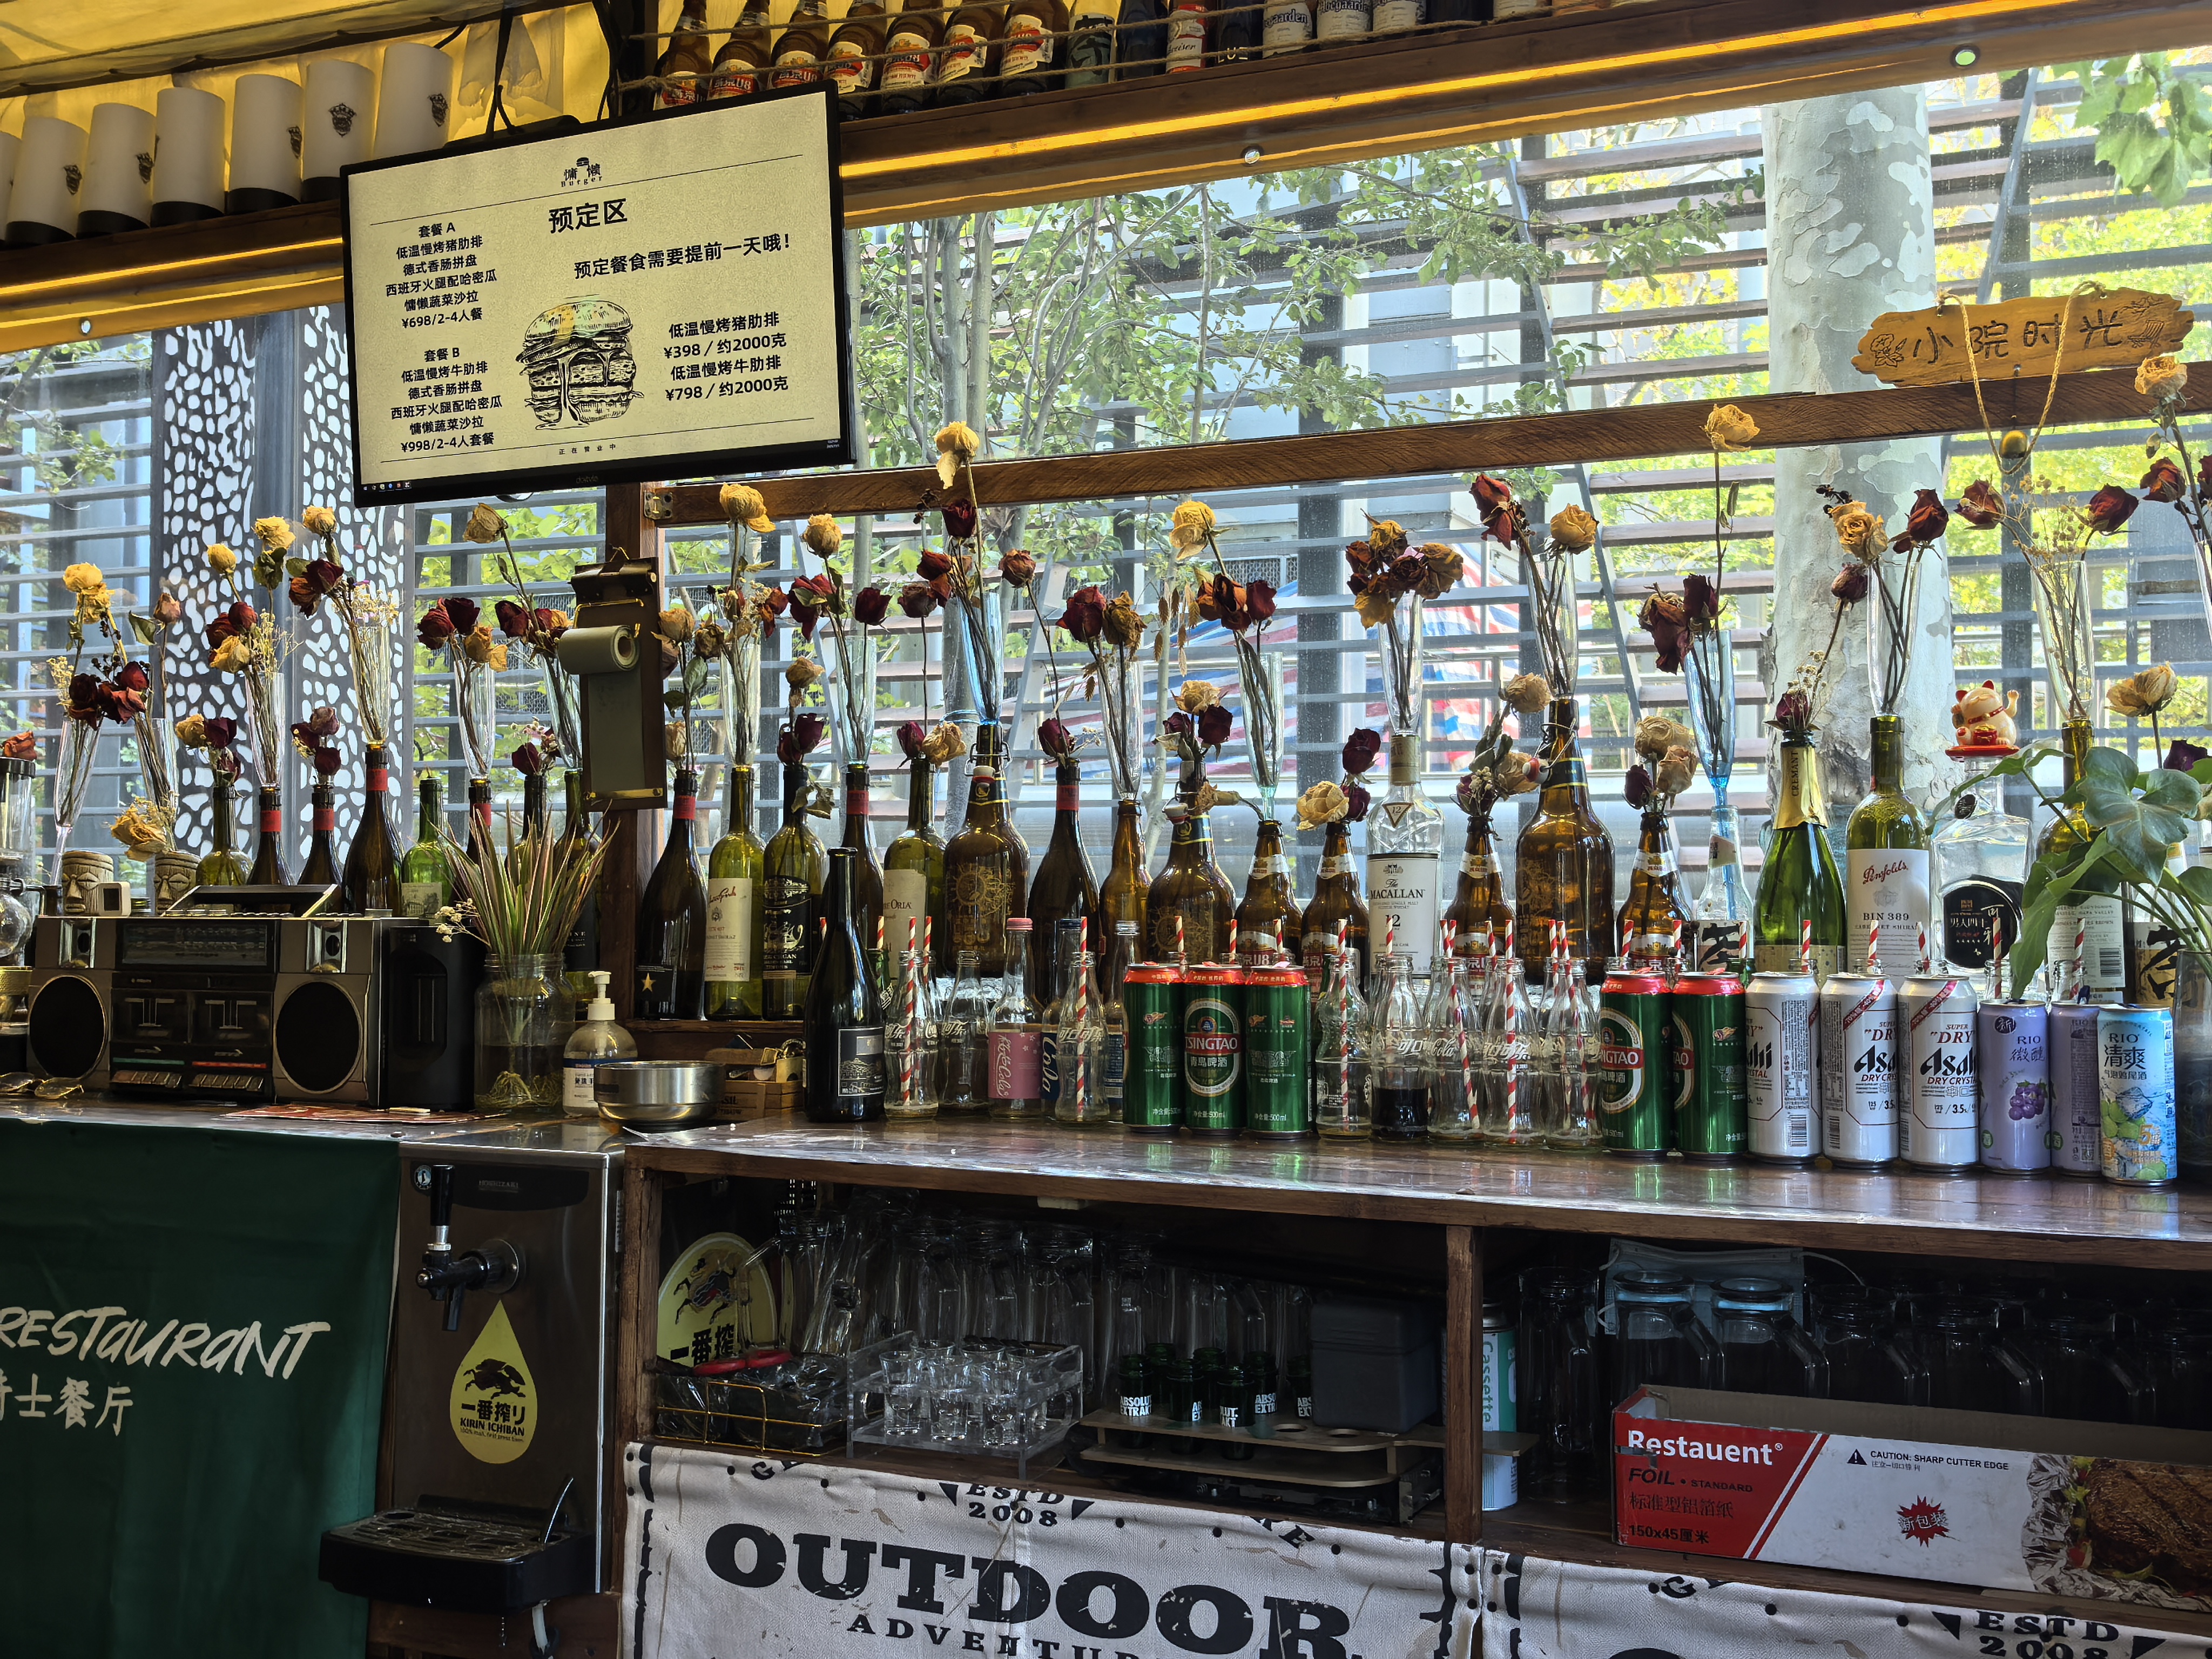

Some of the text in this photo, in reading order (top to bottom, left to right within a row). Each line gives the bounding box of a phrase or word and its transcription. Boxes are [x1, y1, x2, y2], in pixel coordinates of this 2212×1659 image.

[549, 198, 628, 233] 预定区
[419, 222, 456, 238] 套餐 A
[396, 235, 483, 259] 低温慢烤猪肋排
[403, 254, 477, 276] 德式香肠拼盘
[386, 269, 497, 296] 西班牙火腿配哈密瓜
[404, 290, 478, 312] 慵懒蔬菜沙拉
[669, 312, 779, 339] 低温慢烤猪肋排
[1912, 309, 2123, 363] 小院时光
[424, 347, 460, 362] 套餐 B
[401, 361, 488, 383] 低温慢烤牛肋排
[671, 355, 781, 381] 低温慢烤牛肋排
[408, 380, 483, 400] 德式香肠拼盘
[390, 395, 502, 420] 西班牙火腿配哈密瓜
[409, 415, 484, 435] 慵懒蔬菜沙拉
[1385, 879, 1398, 888] The
[1862, 860, 1908, 885] Penfolds
[1370, 889, 1424, 900] MACALLAN
[1887, 912, 1909, 921] 389
[2017, 1035, 2041, 1044] RIO
[2109, 1033, 2139, 1043] RIO
[1191, 1057, 1228, 1067] 青岛啤酒
[2009, 1046, 2046, 1062] 微醺
[2104, 1044, 2146, 1070] 清爽
[1861, 1074, 1879, 1082] DRY
[1927, 1076, 1947, 1085] DRY
[1482, 1340, 1493, 1423] Cassette
[461, 1399, 526, 1425] 一番搾り
[460, 1417, 525, 1437] KIRIN ICHIBAN
[1870, 1451, 2009, 1470] CAUTION: SHARP CUTTER EDGE
[1628, 1467, 1753, 1493] FOIL STANDARD
[969, 1501, 1058, 1527] 2008
[1629, 1492, 1734, 1520] 标准型铝箔纸
[1628, 1524, 1710, 1545] 150x45厘米
[704, 1523, 1363, 1659] OUTDOOR
